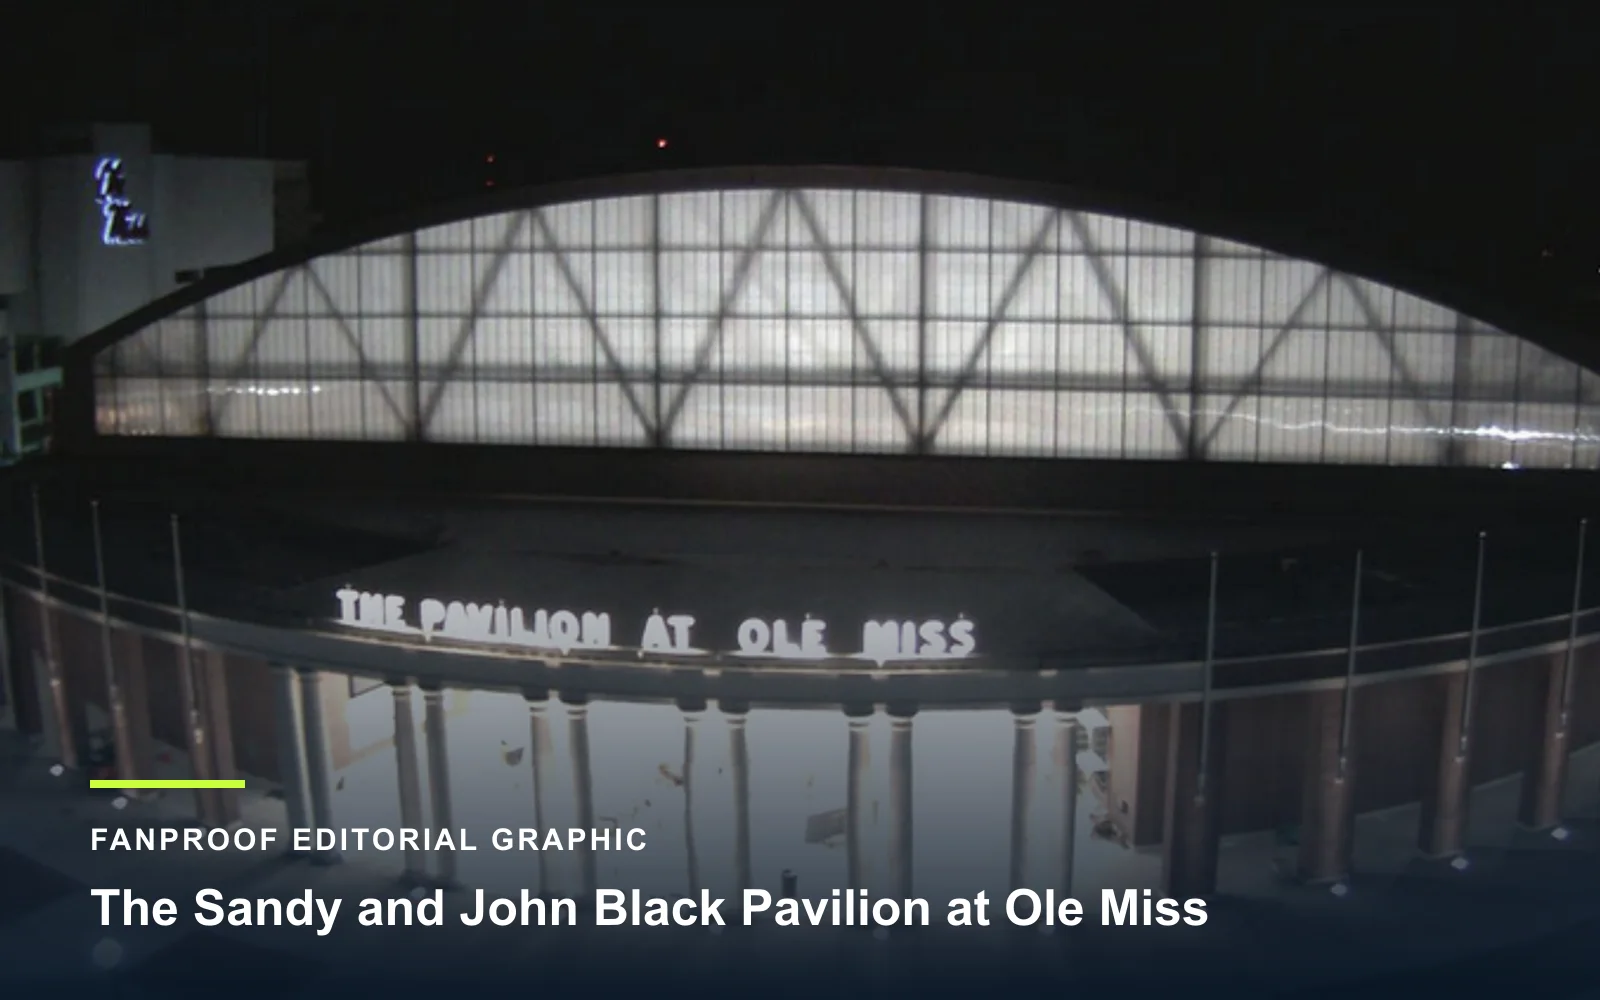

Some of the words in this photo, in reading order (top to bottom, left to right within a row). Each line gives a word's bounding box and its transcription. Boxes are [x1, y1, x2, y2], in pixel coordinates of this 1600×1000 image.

[336, 587, 406, 628] THE
[420, 597, 611, 650] PAVILION
[641, 613, 696, 653] AT
[737, 617, 827, 657] OLE
[863, 619, 976, 658] MISS
